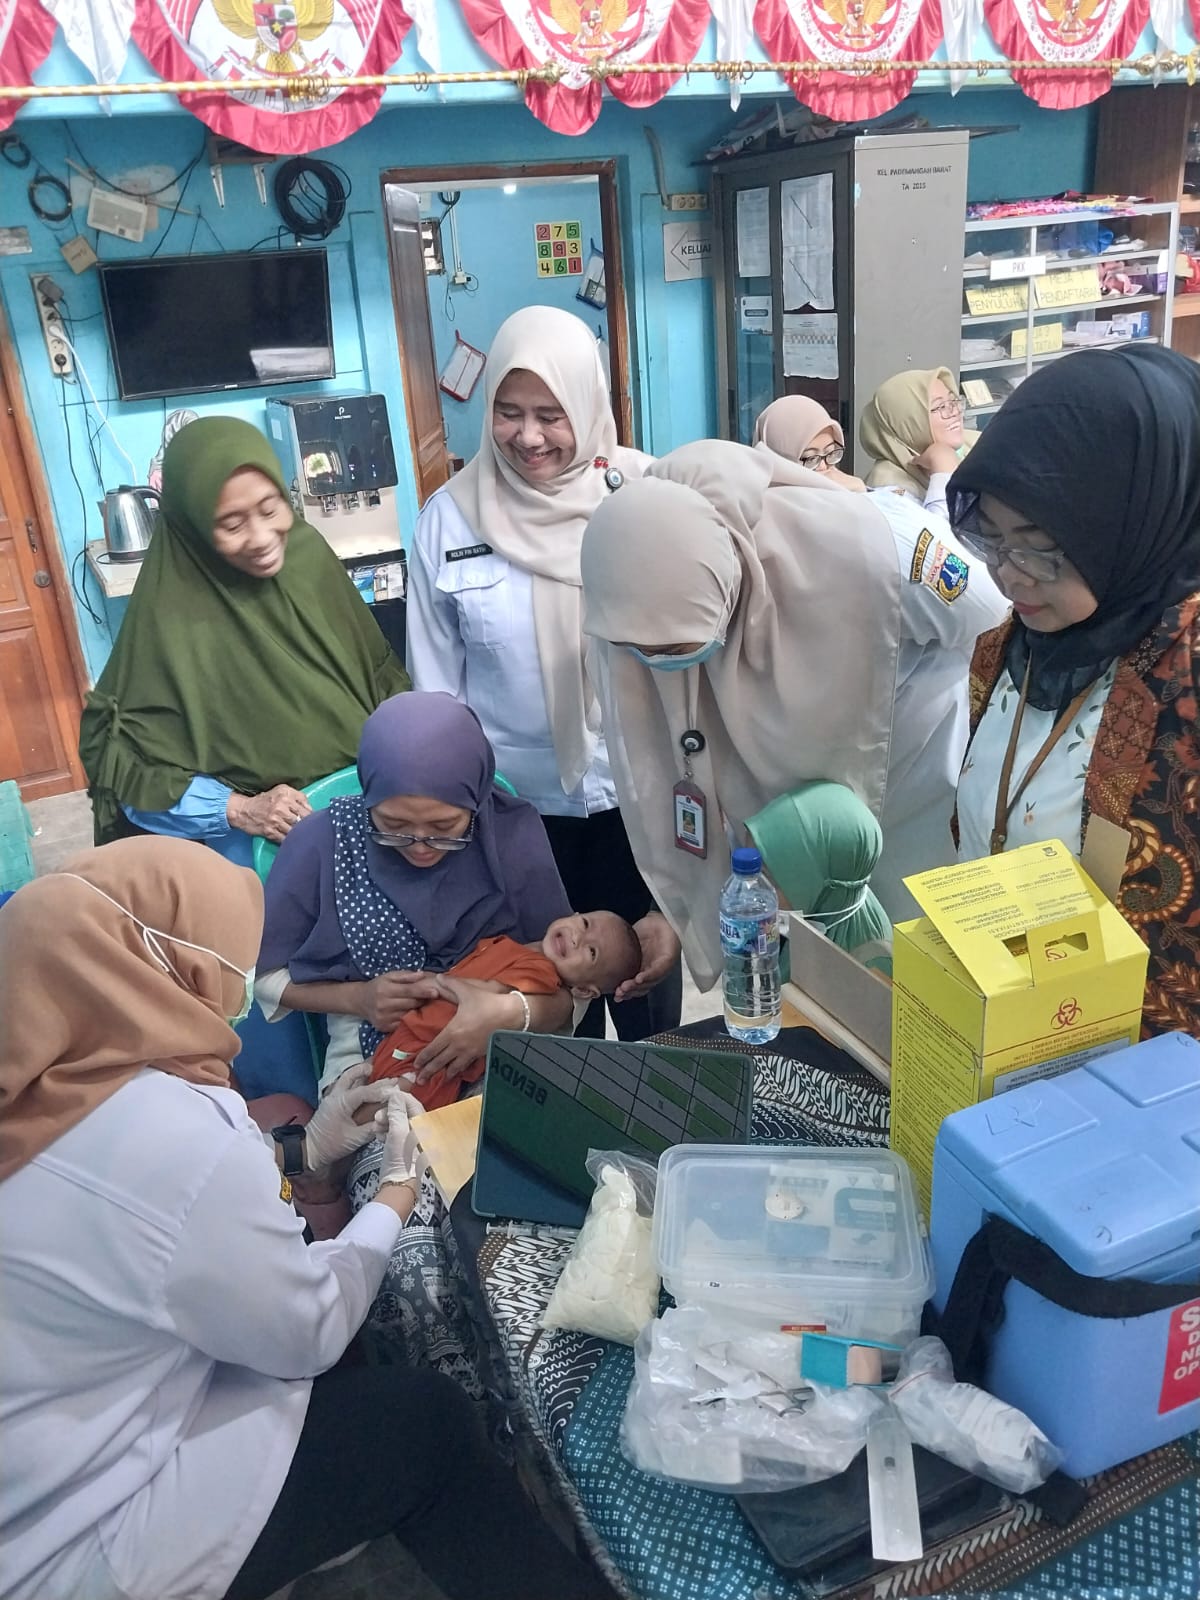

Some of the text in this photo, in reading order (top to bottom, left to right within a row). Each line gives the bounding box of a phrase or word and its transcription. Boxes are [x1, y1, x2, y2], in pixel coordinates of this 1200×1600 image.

[540, 225, 577, 238] 2 7 5
[540, 243, 578, 256] 8 9 3
[541, 260, 577, 274] 4 6 1
[969, 298, 1027, 311] PENYULUHA
[720, 919, 741, 939] QUA
[1180, 1306, 1200, 1331] S
[1188, 1330, 1200, 1346] D
[1181, 1345, 1200, 1364] NE
[1173, 1360, 1199, 1381] OP
